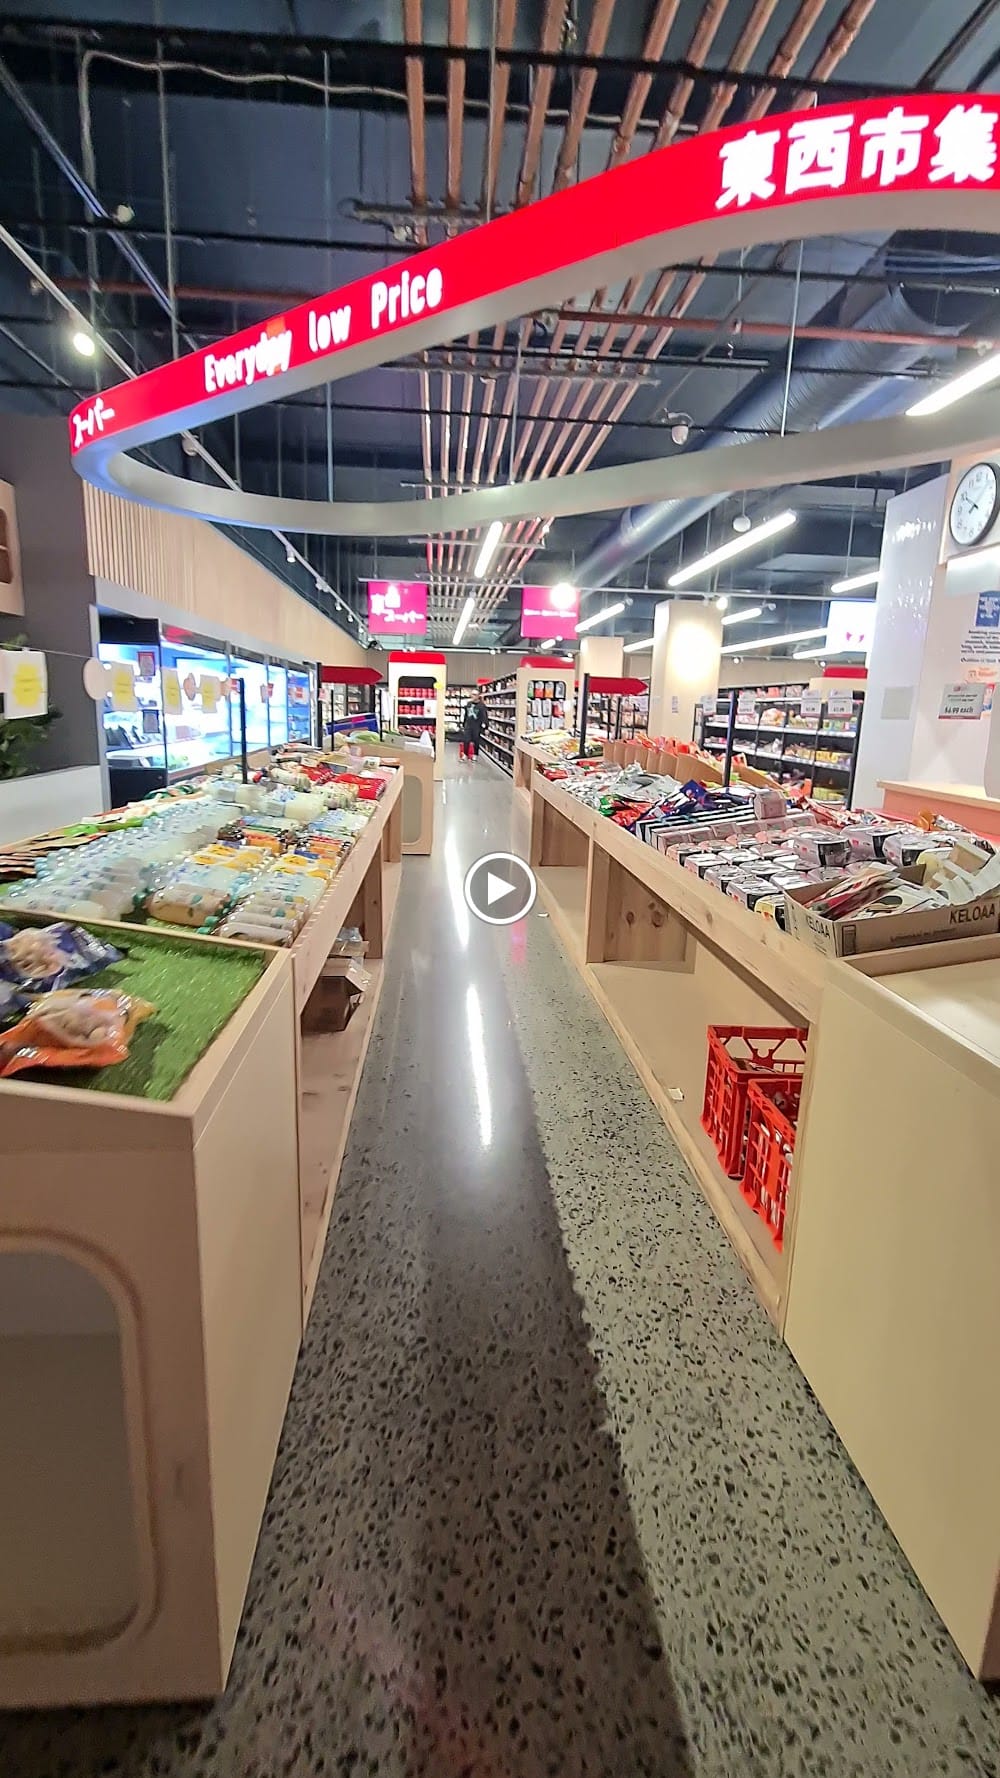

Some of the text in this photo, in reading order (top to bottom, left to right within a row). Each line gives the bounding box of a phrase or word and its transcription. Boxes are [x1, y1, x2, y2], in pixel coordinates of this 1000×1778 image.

[715, 104, 999, 210] 東西市集
[204, 268, 443, 393] Everyday low Price
[949, 903, 996, 925] KELOAA
